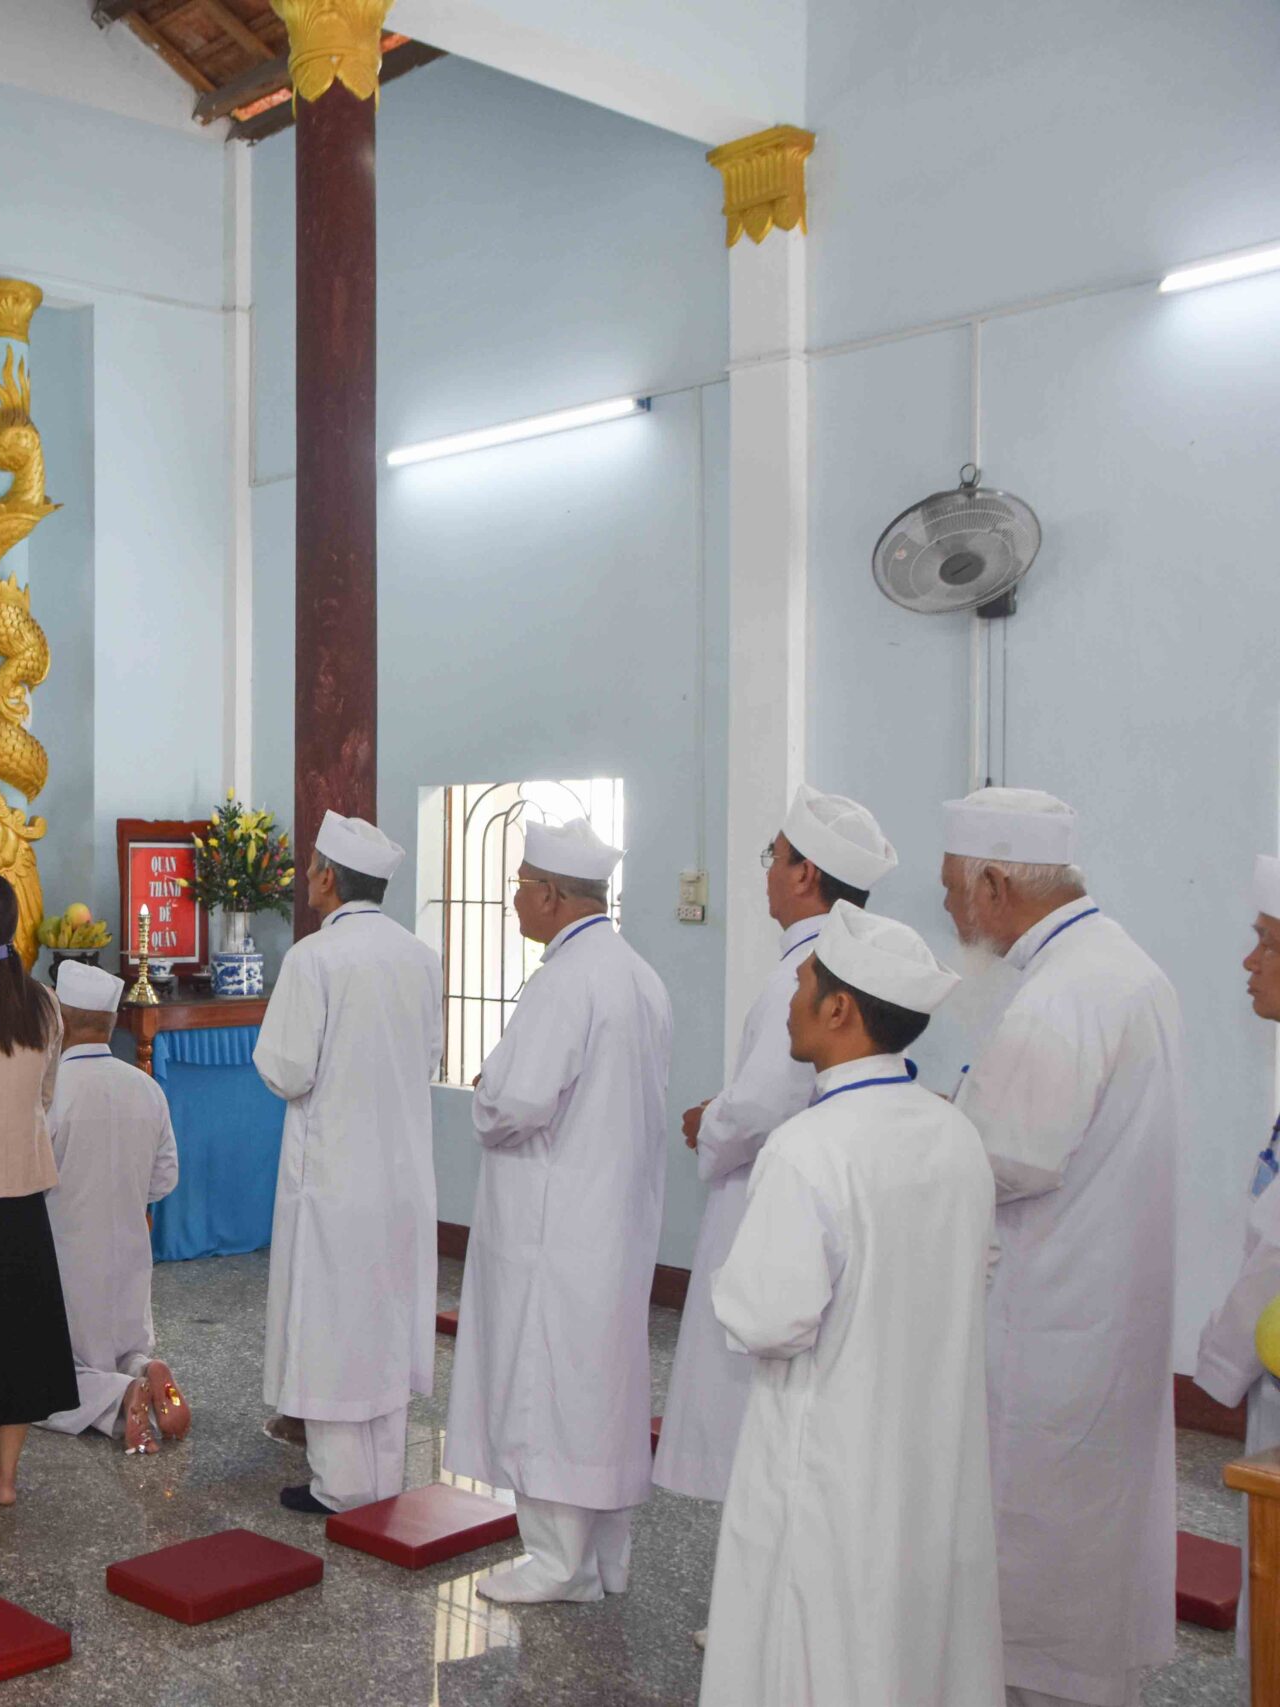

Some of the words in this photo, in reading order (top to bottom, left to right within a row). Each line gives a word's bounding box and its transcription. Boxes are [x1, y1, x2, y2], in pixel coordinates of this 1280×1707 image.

[151, 857, 176, 876] QUAN
[149, 876, 182, 897] THÁNH
[151, 927, 177, 951] QUÂN
